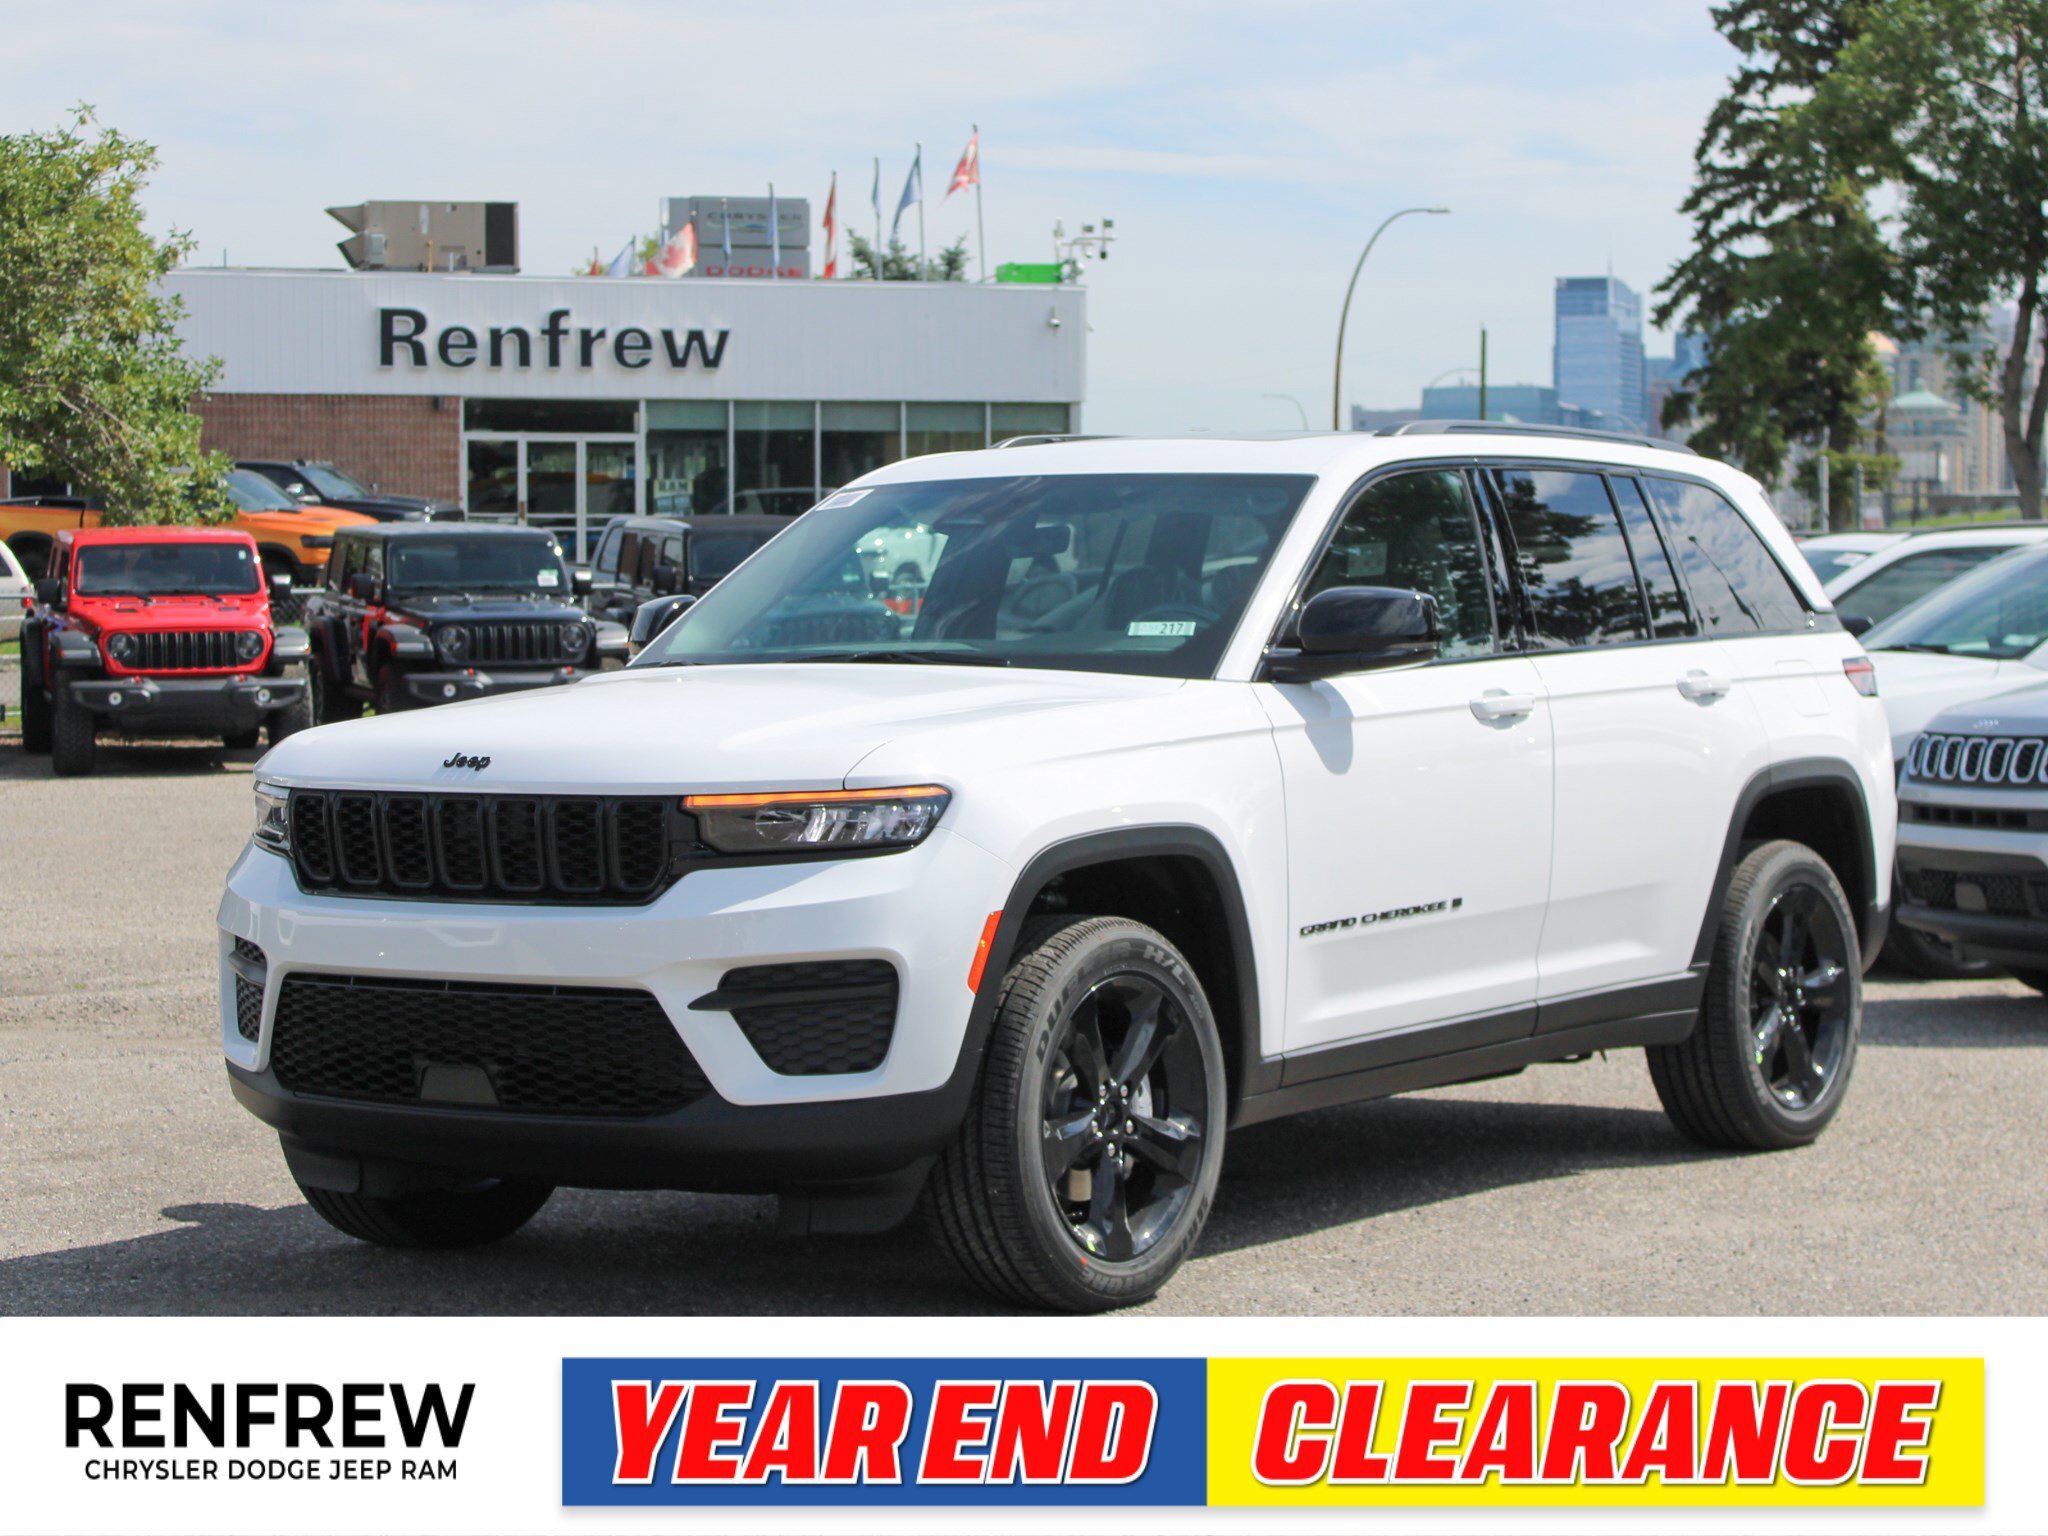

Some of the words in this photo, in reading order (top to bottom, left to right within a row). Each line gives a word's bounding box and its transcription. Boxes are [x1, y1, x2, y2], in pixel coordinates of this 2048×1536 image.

[707, 211, 803, 220] CHRYSER
[378, 307, 731, 369] Renfrew
[443, 752, 491, 771] Jeep
[1300, 916, 1357, 936] GRAND
[1361, 900, 1449, 924] CHEROKEE
